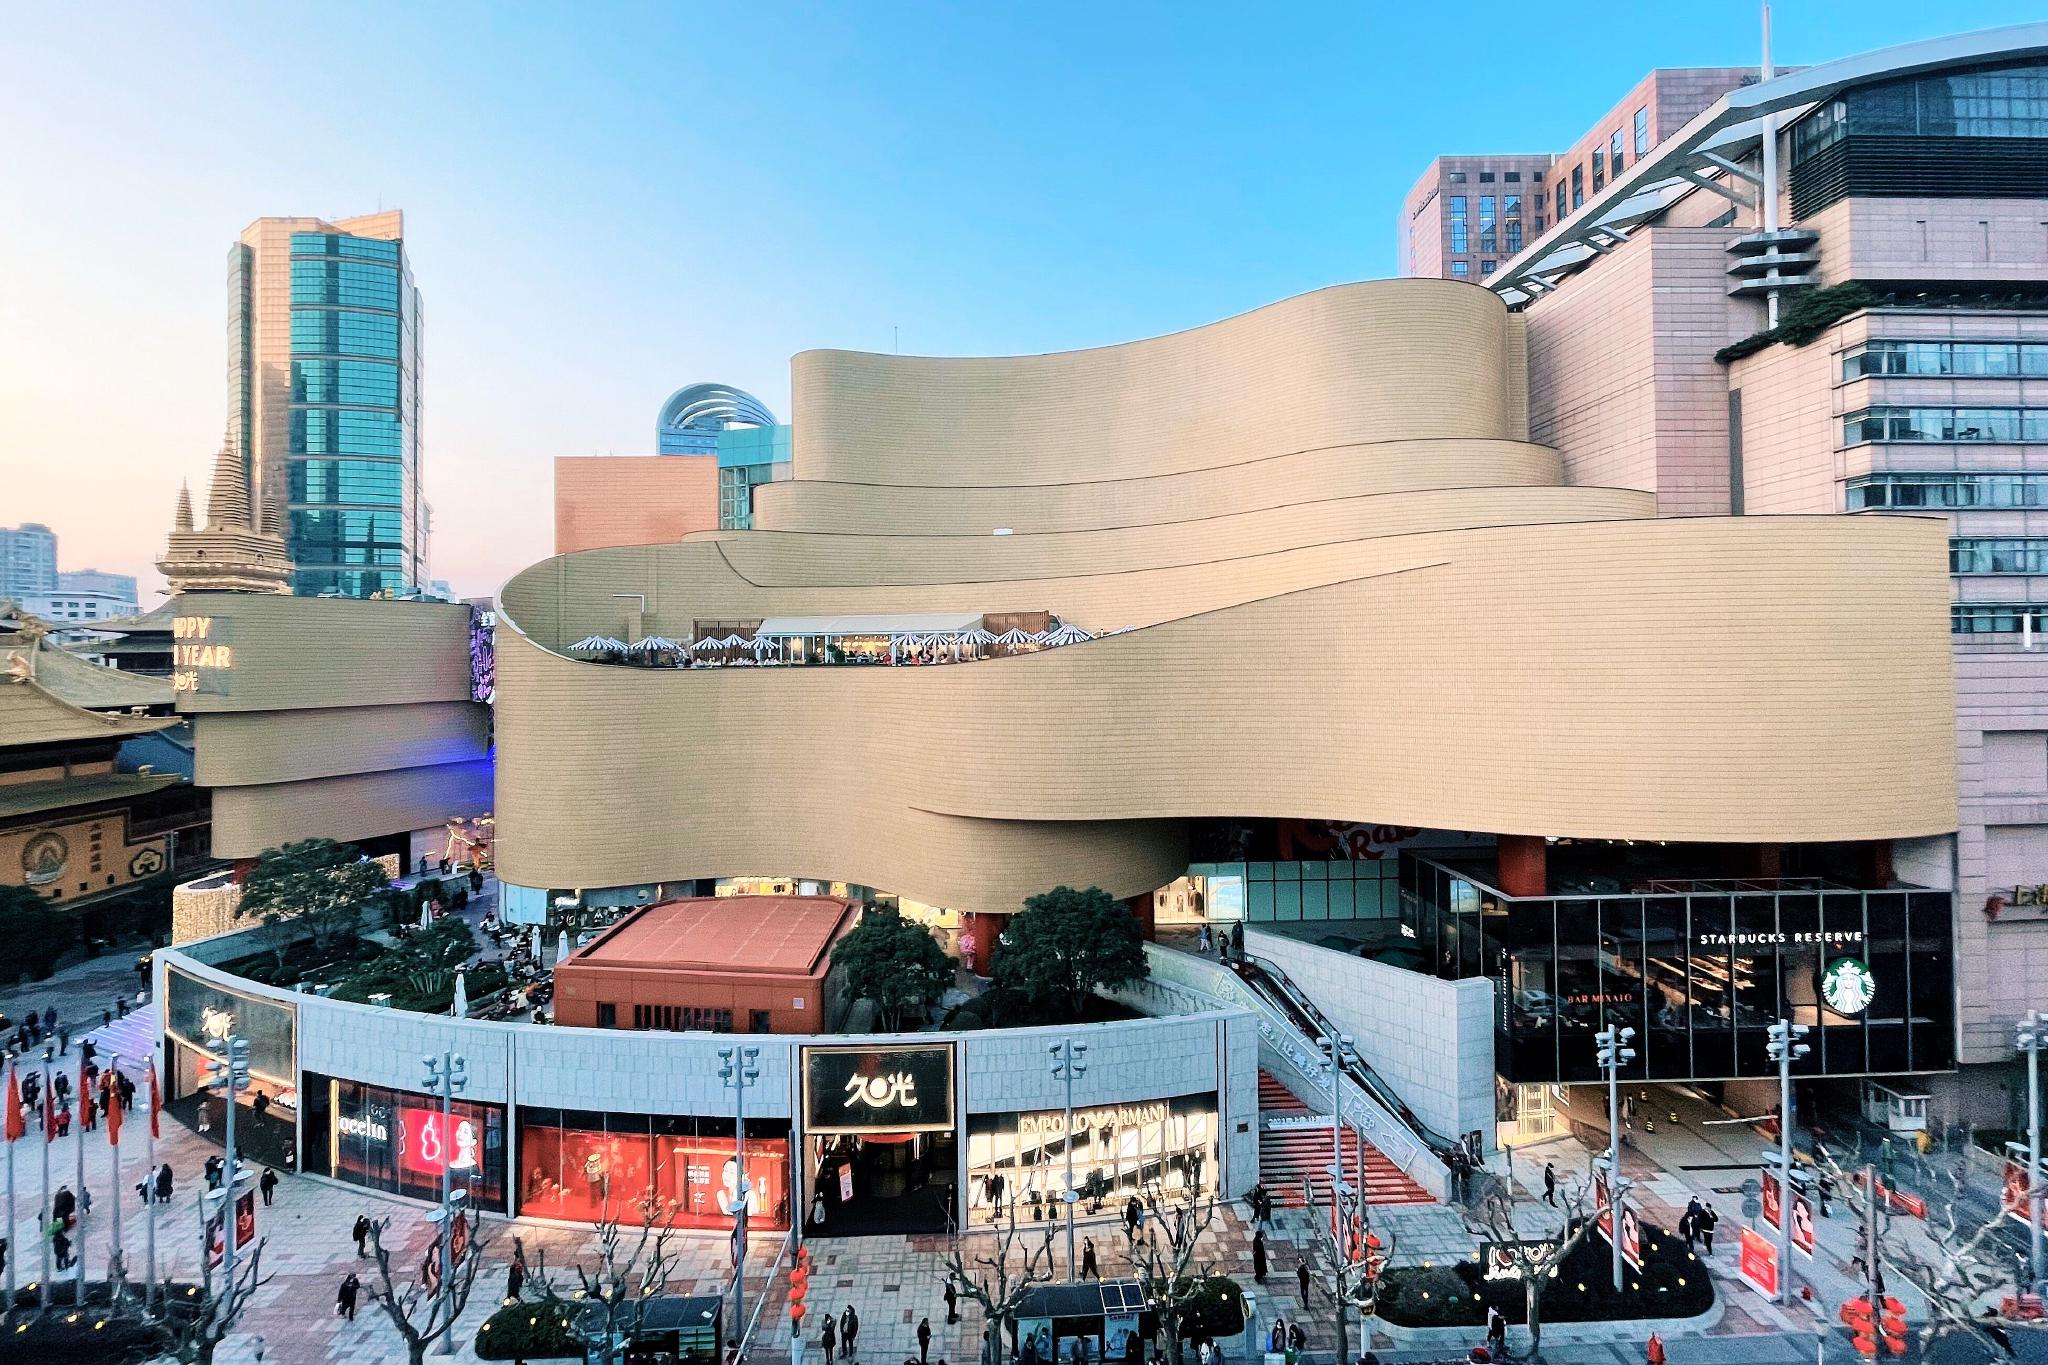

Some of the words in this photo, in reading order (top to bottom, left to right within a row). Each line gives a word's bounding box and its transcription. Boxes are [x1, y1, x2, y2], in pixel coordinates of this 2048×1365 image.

[181, 645, 231, 668] YEAR
[1700, 932, 1786, 945] STARBUCKS
[1794, 931, 1863, 943] RESERVE
[1567, 994, 1589, 1004] BAR
[843, 1070, 918, 1108] 久光
[338, 1115, 388, 1141] ocelin
[1020, 1112, 1090, 1135] EMPOIO
[1108, 1102, 1166, 1128] ARMANI
